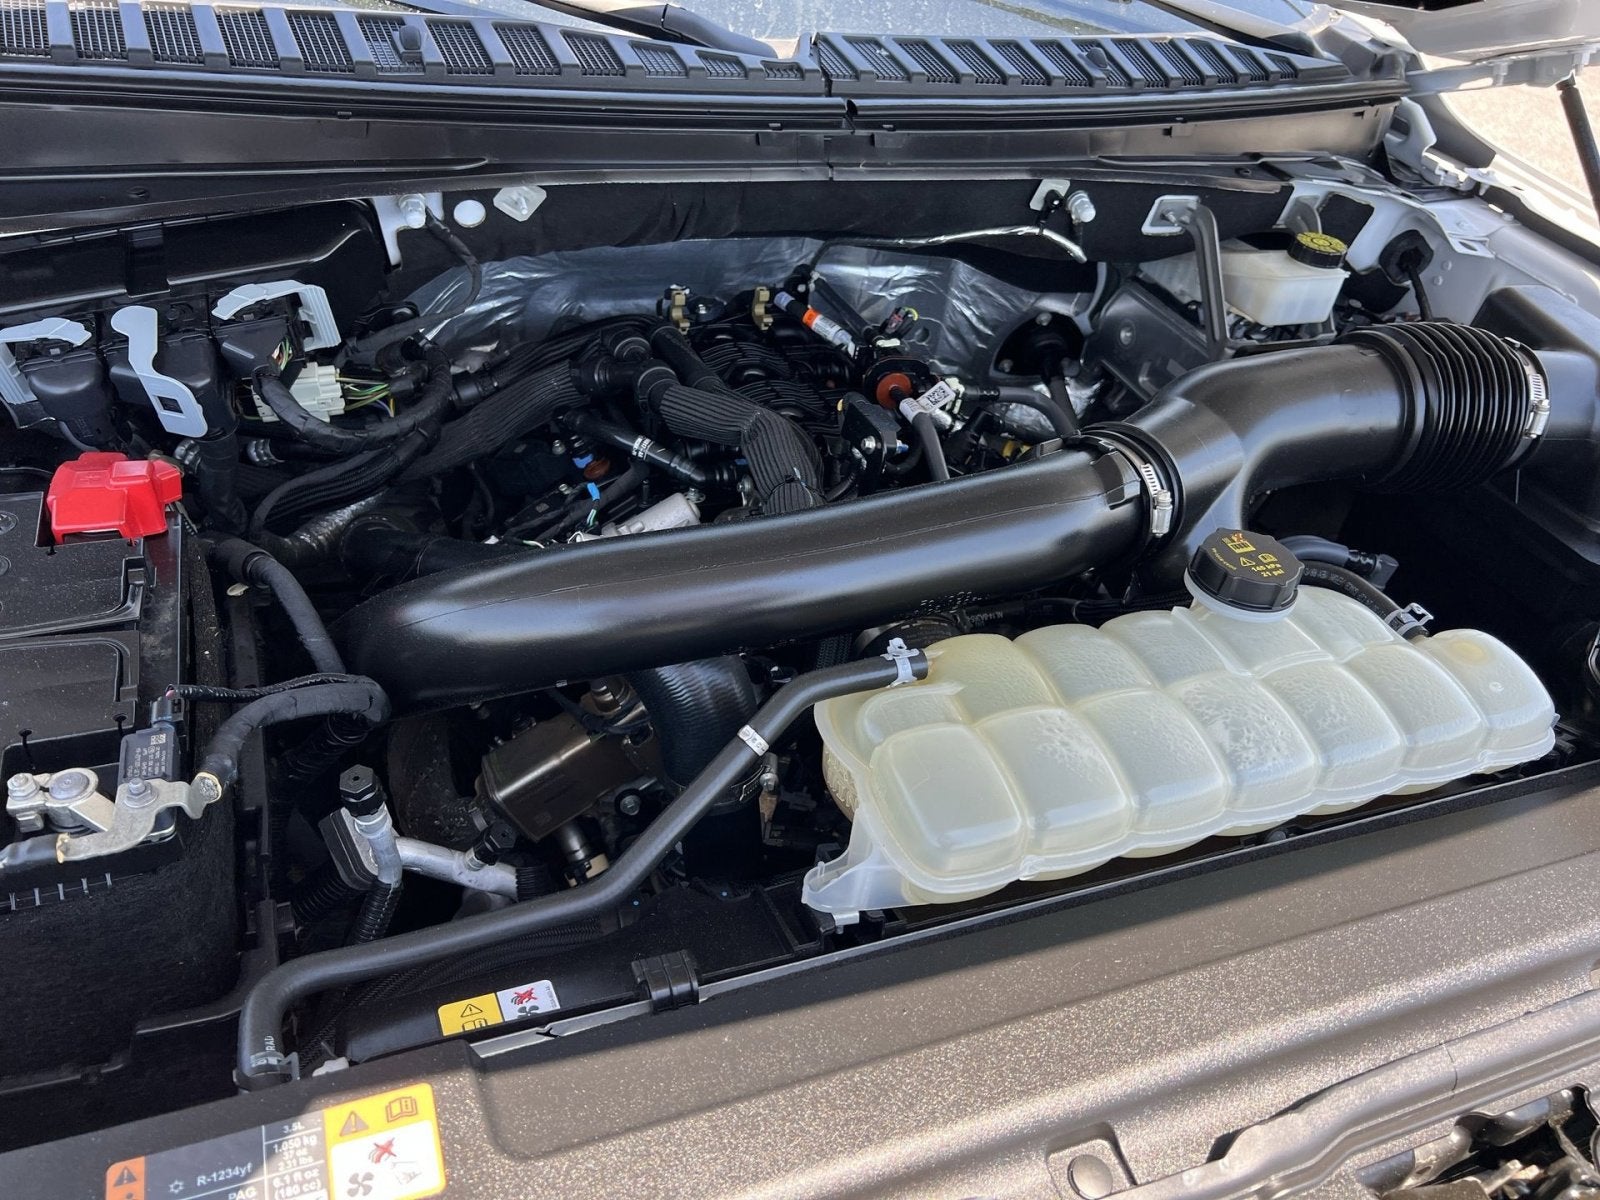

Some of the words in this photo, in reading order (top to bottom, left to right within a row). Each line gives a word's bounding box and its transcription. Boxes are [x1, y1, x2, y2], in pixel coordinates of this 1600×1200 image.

[273, 1137, 302, 1153] 1.050
[302, 1134, 318, 1147] kg
[282, 1150, 295, 1161] 37
[295, 1147, 308, 1157] oz
[298, 1155, 314, 1166] lbs
[196, 1162, 253, 1187] R-1234yf
[272, 1173, 291, 1188] 6.1
[292, 1170, 303, 1182] fl
[303, 1168, 320, 1180] oz
[302, 1178, 322, 1192] cc)
